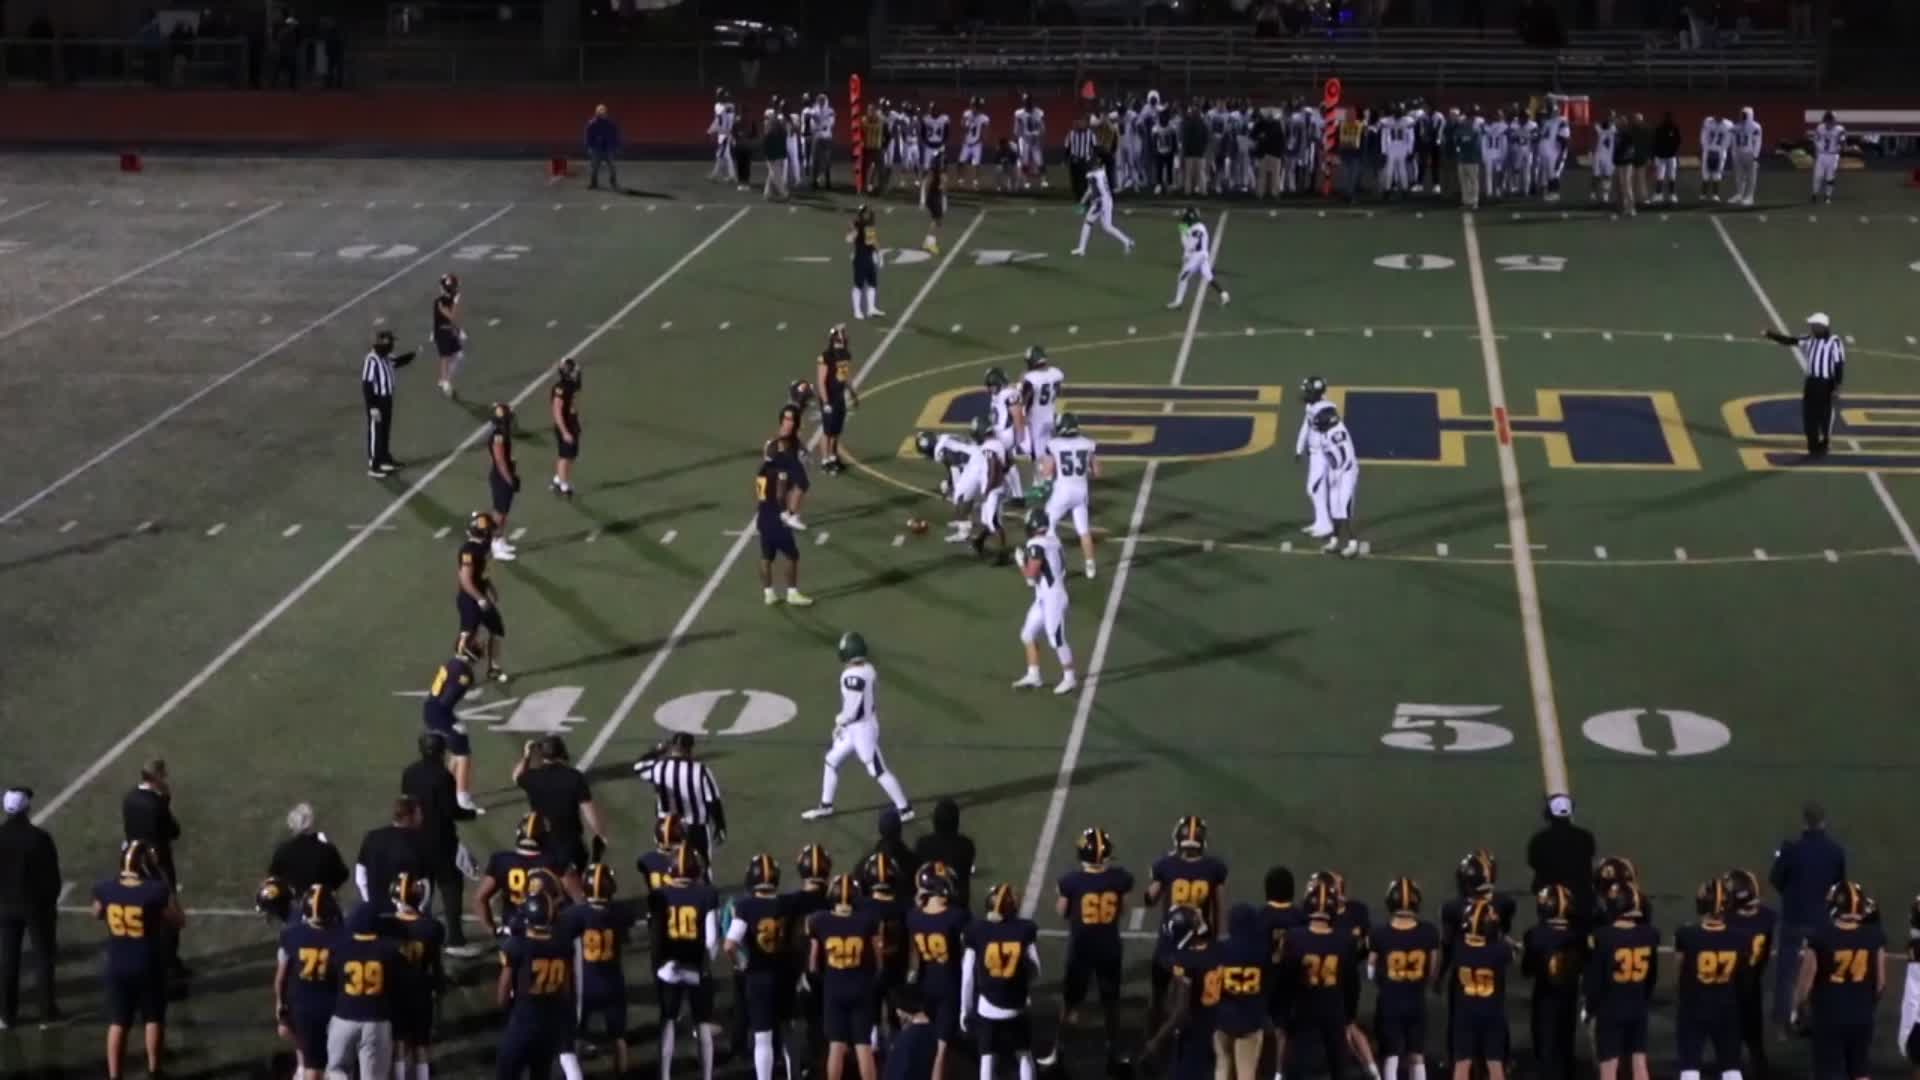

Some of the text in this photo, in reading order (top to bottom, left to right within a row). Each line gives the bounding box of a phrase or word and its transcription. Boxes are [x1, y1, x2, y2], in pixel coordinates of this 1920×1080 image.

[1060, 451, 1090, 477] 53
[1379, 702, 1732, 757] 50
[343, 960, 384, 996] 39
[1613, 947, 1651, 983] 35
